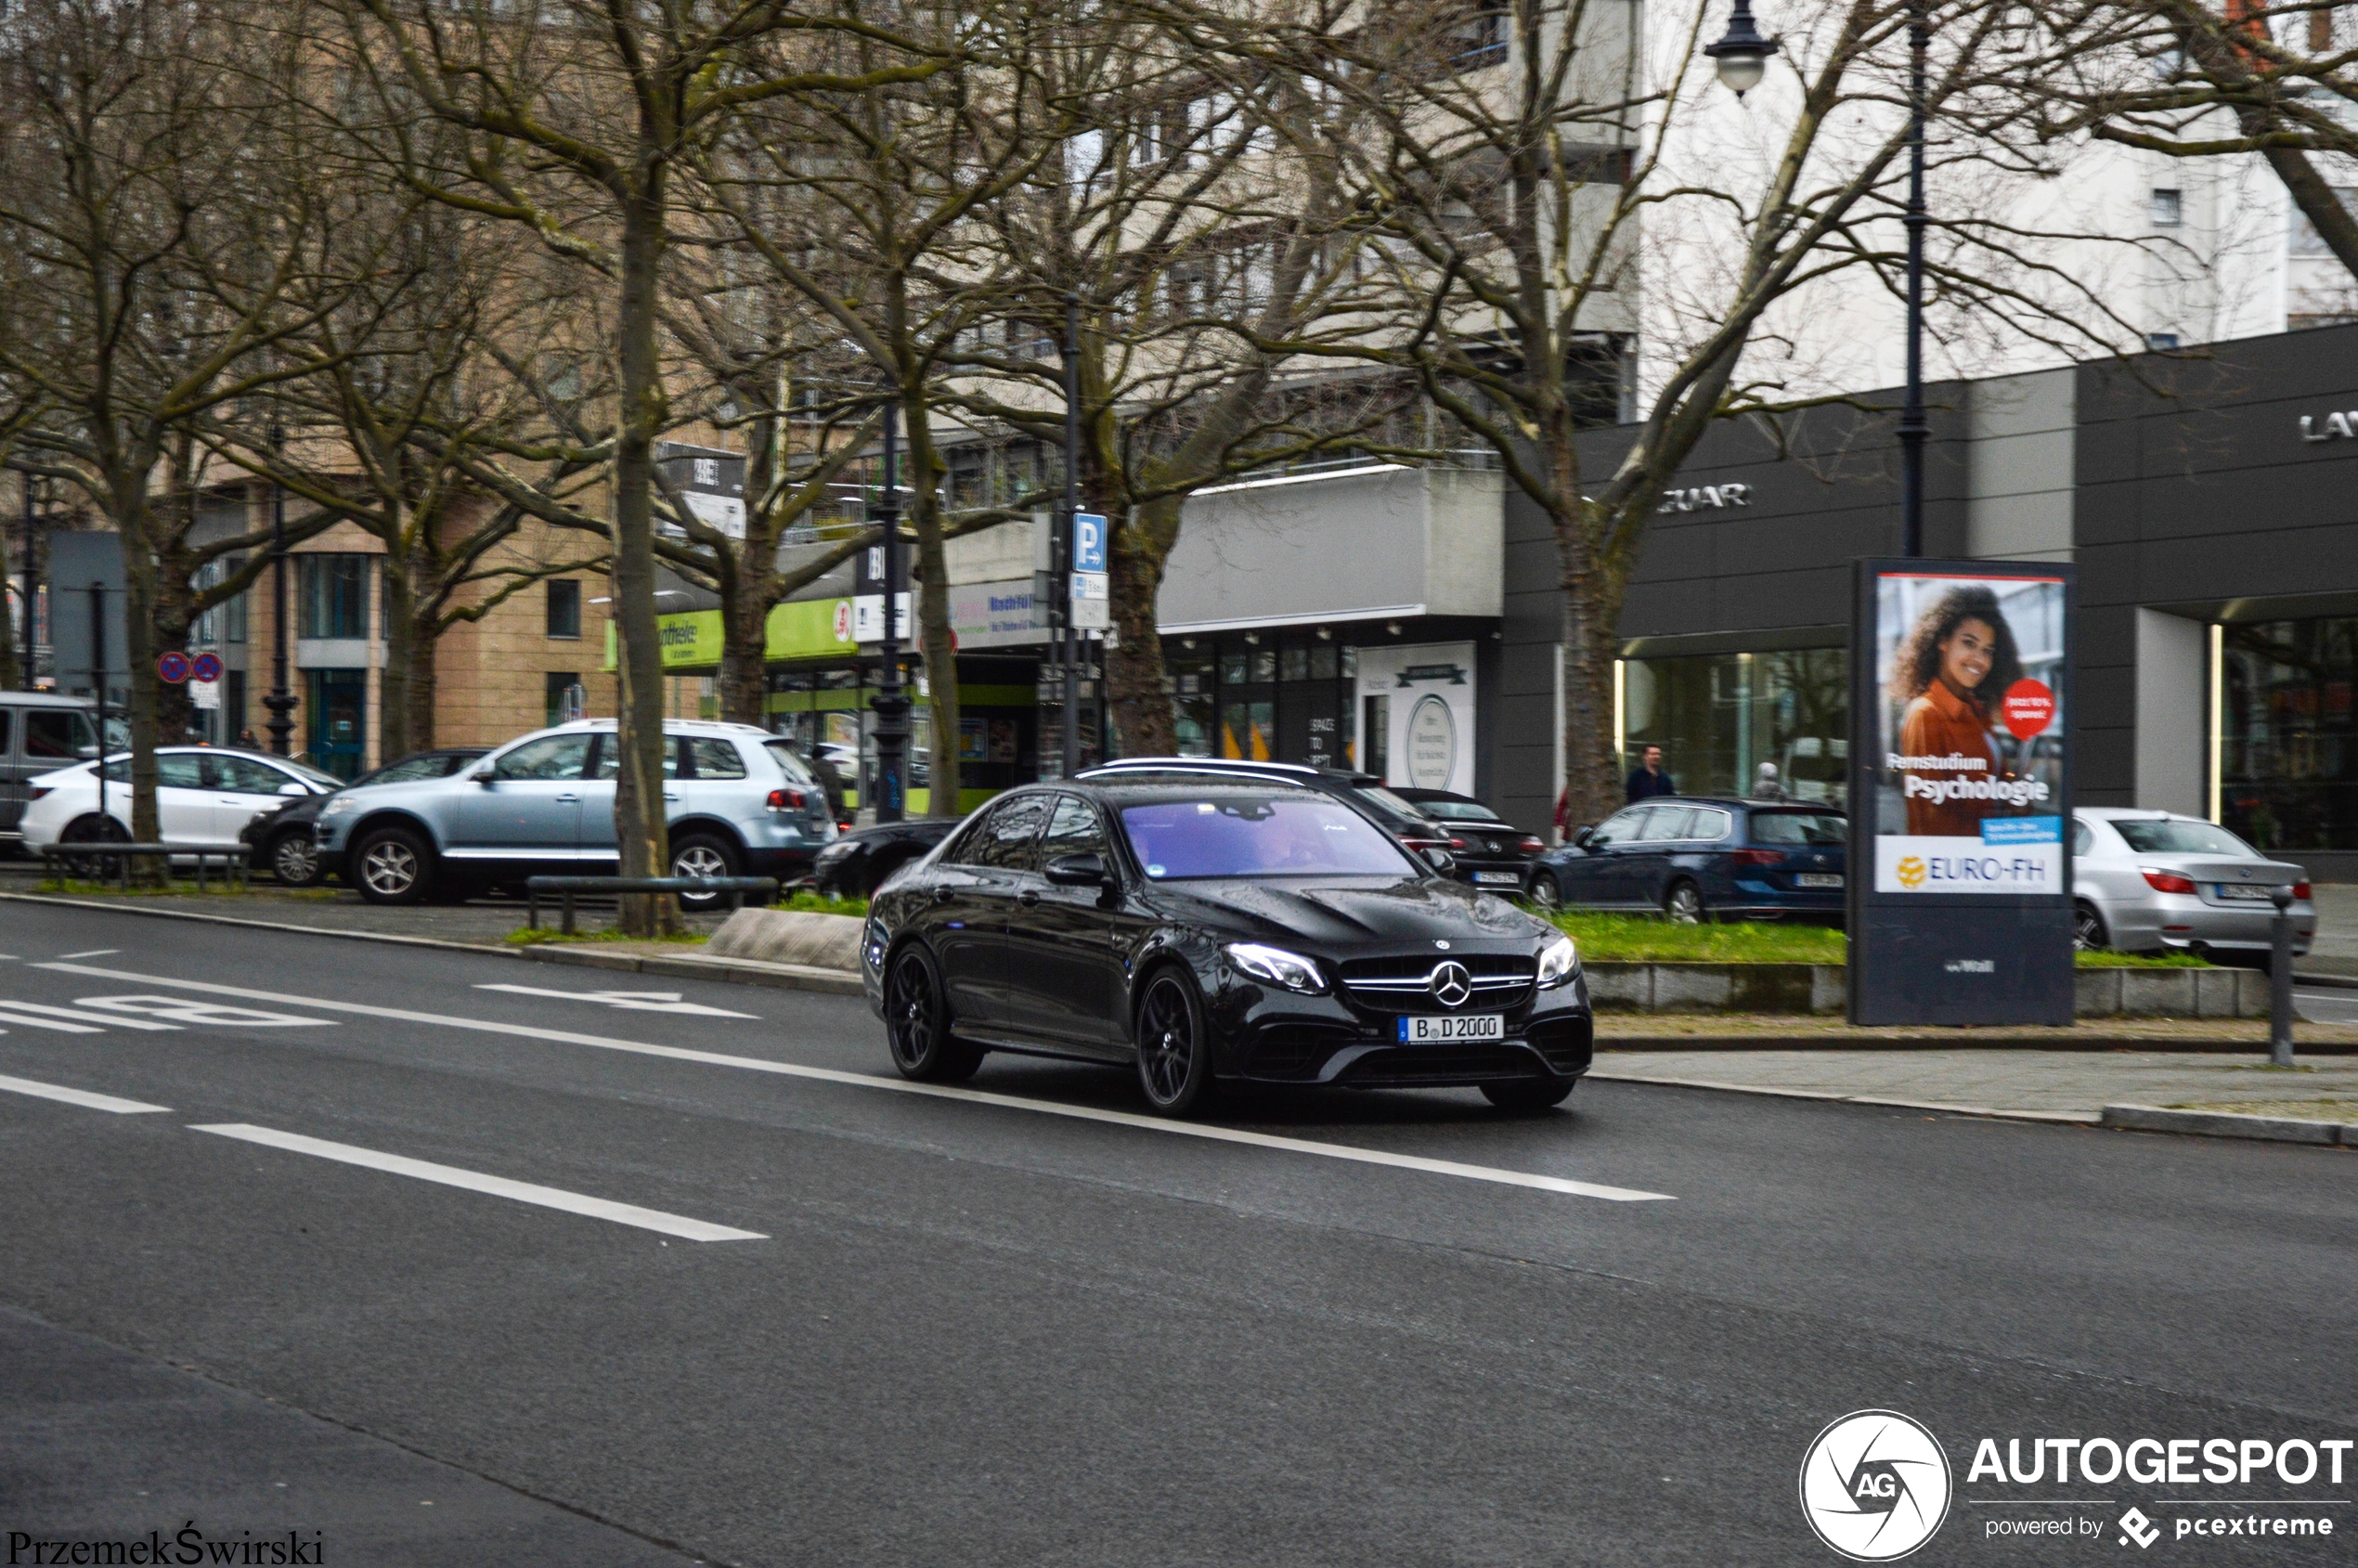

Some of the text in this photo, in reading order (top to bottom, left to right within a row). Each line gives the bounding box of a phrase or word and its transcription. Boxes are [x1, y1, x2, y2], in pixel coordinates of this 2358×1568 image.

[1078, 521, 1098, 564] P
[1886, 751, 1987, 771] Fernstudium
[1904, 773, 2050, 806] Psychologie
[1929, 857, 2045, 881] EURO-FH
[1417, 1019, 1429, 1038] B
[1442, 1018, 1453, 1037] D
[1457, 1017, 1497, 1036] 2000
